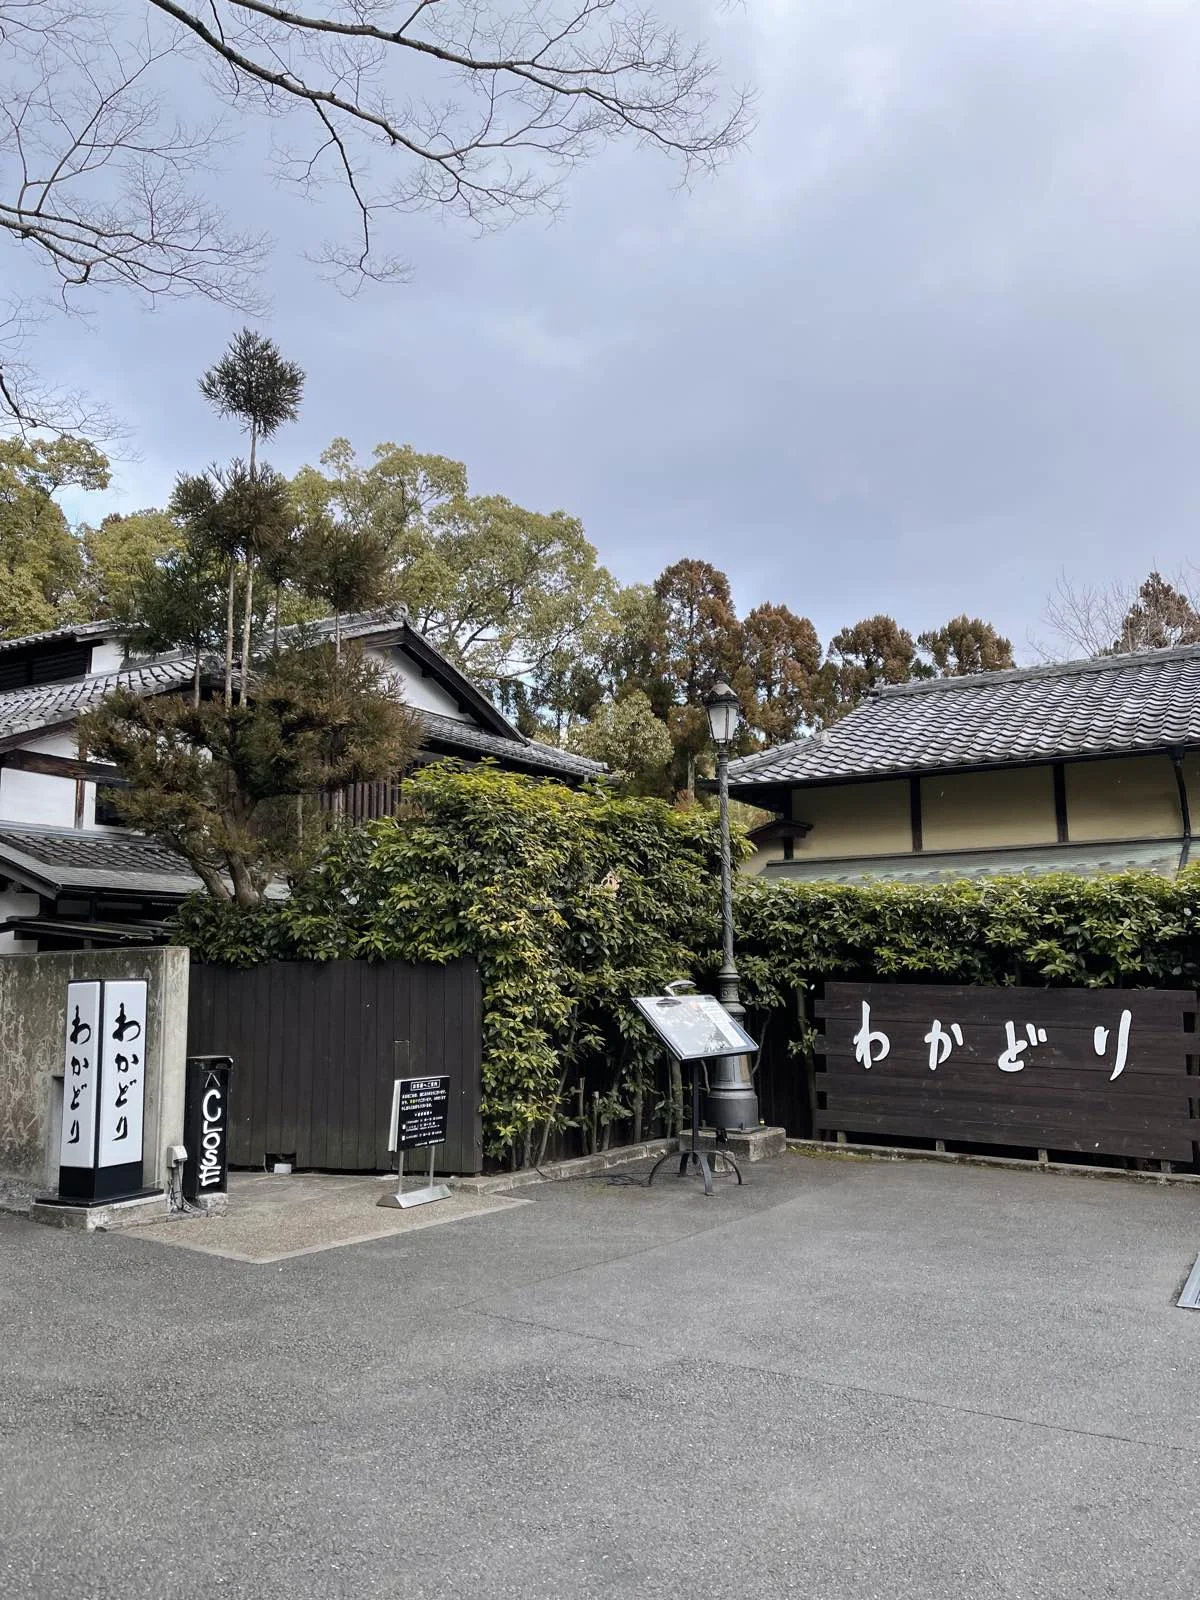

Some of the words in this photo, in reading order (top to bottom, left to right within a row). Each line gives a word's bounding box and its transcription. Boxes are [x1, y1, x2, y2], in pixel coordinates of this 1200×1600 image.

[67, 1005, 91, 1144] わかどり
[111, 1002, 142, 1142] わかどり
[853, 1000, 1132, 1081] わかどり
[199, 1090, 222, 1186] CLOSE
